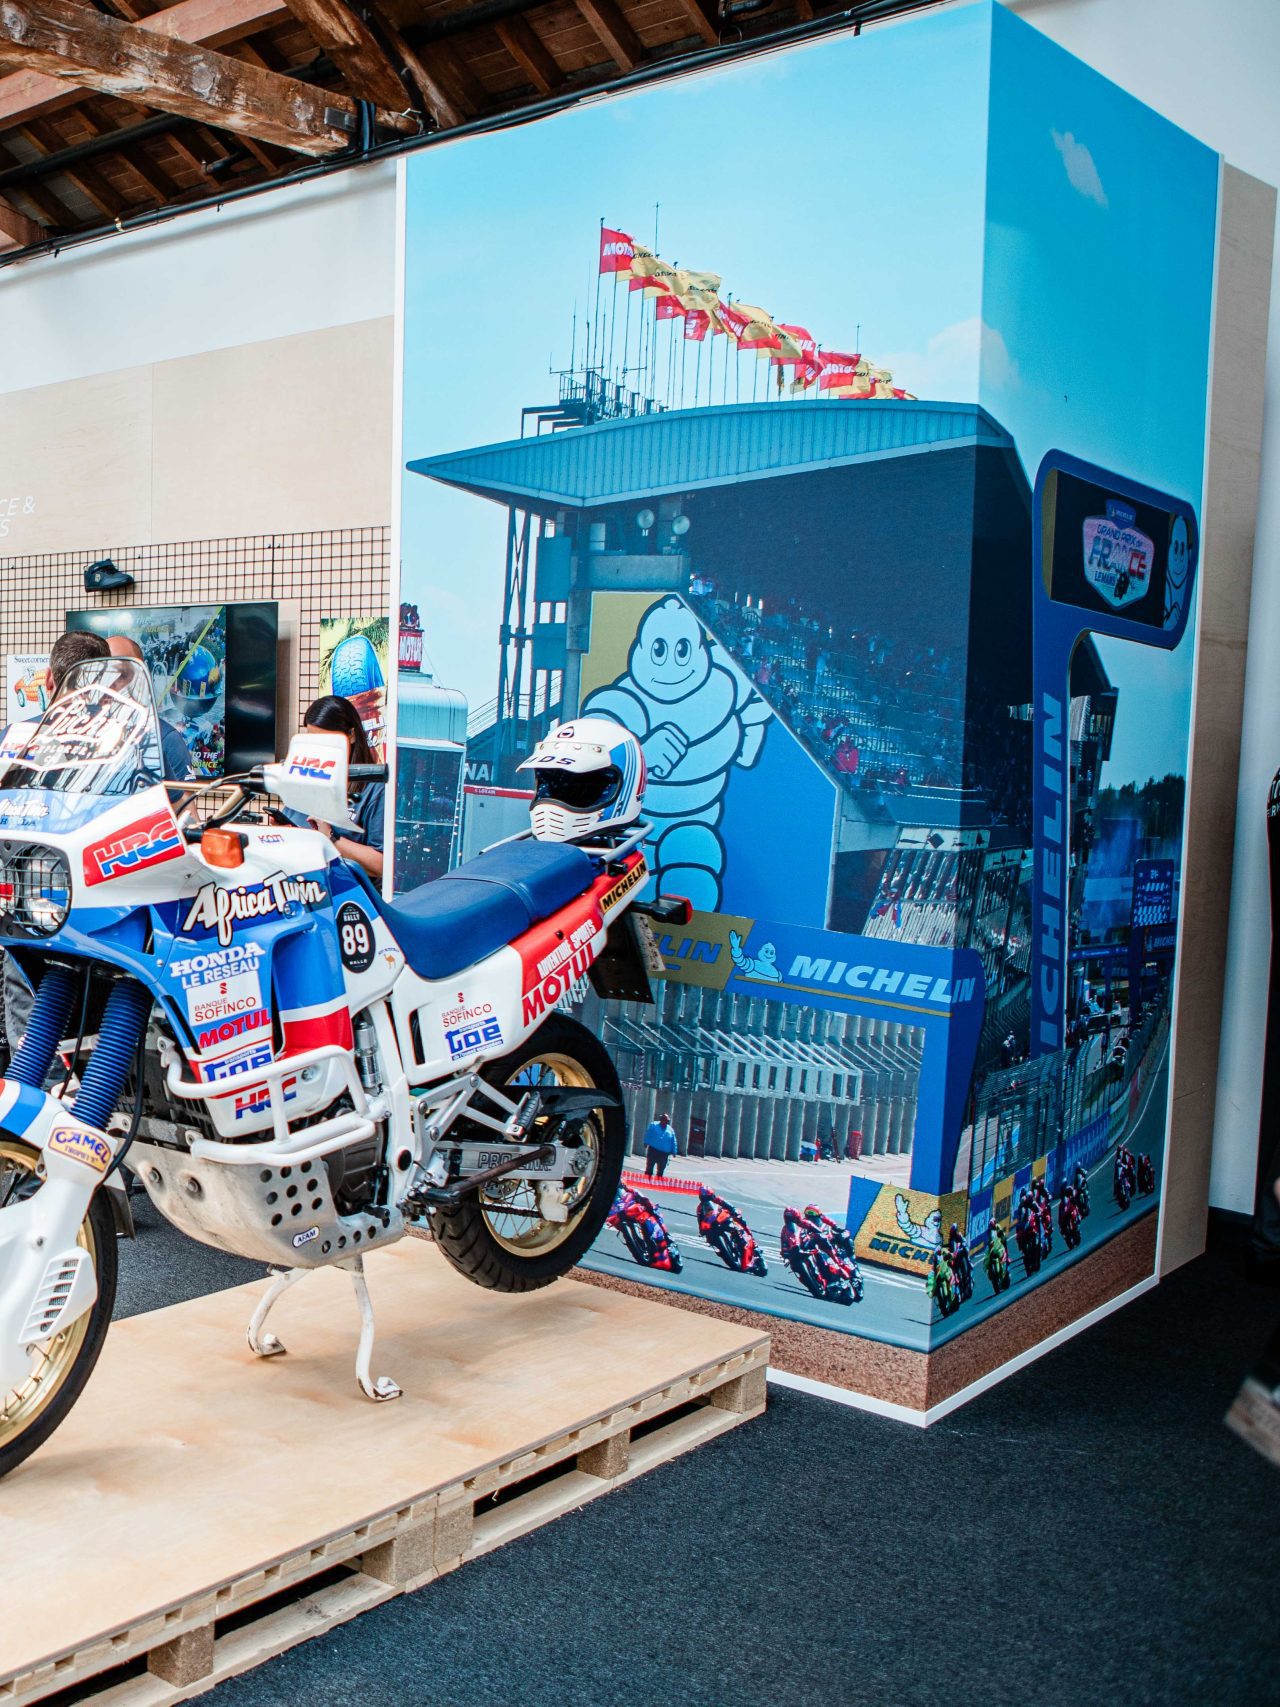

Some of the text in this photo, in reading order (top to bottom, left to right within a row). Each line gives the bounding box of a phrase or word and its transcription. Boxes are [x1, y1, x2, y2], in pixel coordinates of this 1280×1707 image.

[22, 496, 36, 514] &
[289, 756, 336, 780] HRC
[93, 819, 182, 878] HRC
[602, 861, 647, 910] MICHELIN
[182, 870, 328, 946] Africa Twin
[343, 913, 360, 922] RALLY
[341, 923, 370, 956] 89
[570, 919, 597, 947] SPORTS
[169, 942, 267, 978] HONDA
[181, 957, 260, 990] LE RESEAU
[521, 941, 596, 1028] MOTUL
[788, 955, 976, 1004] MICHELIN
[194, 998, 227, 1011] BANQUE
[195, 997, 257, 1022] SOFINCO
[441, 1005, 466, 1018] BANQUE
[442, 1003, 492, 1028] SOFINCO
[199, 1008, 271, 1048] MOTUL
[55, 1131, 108, 1164] CAMEL
